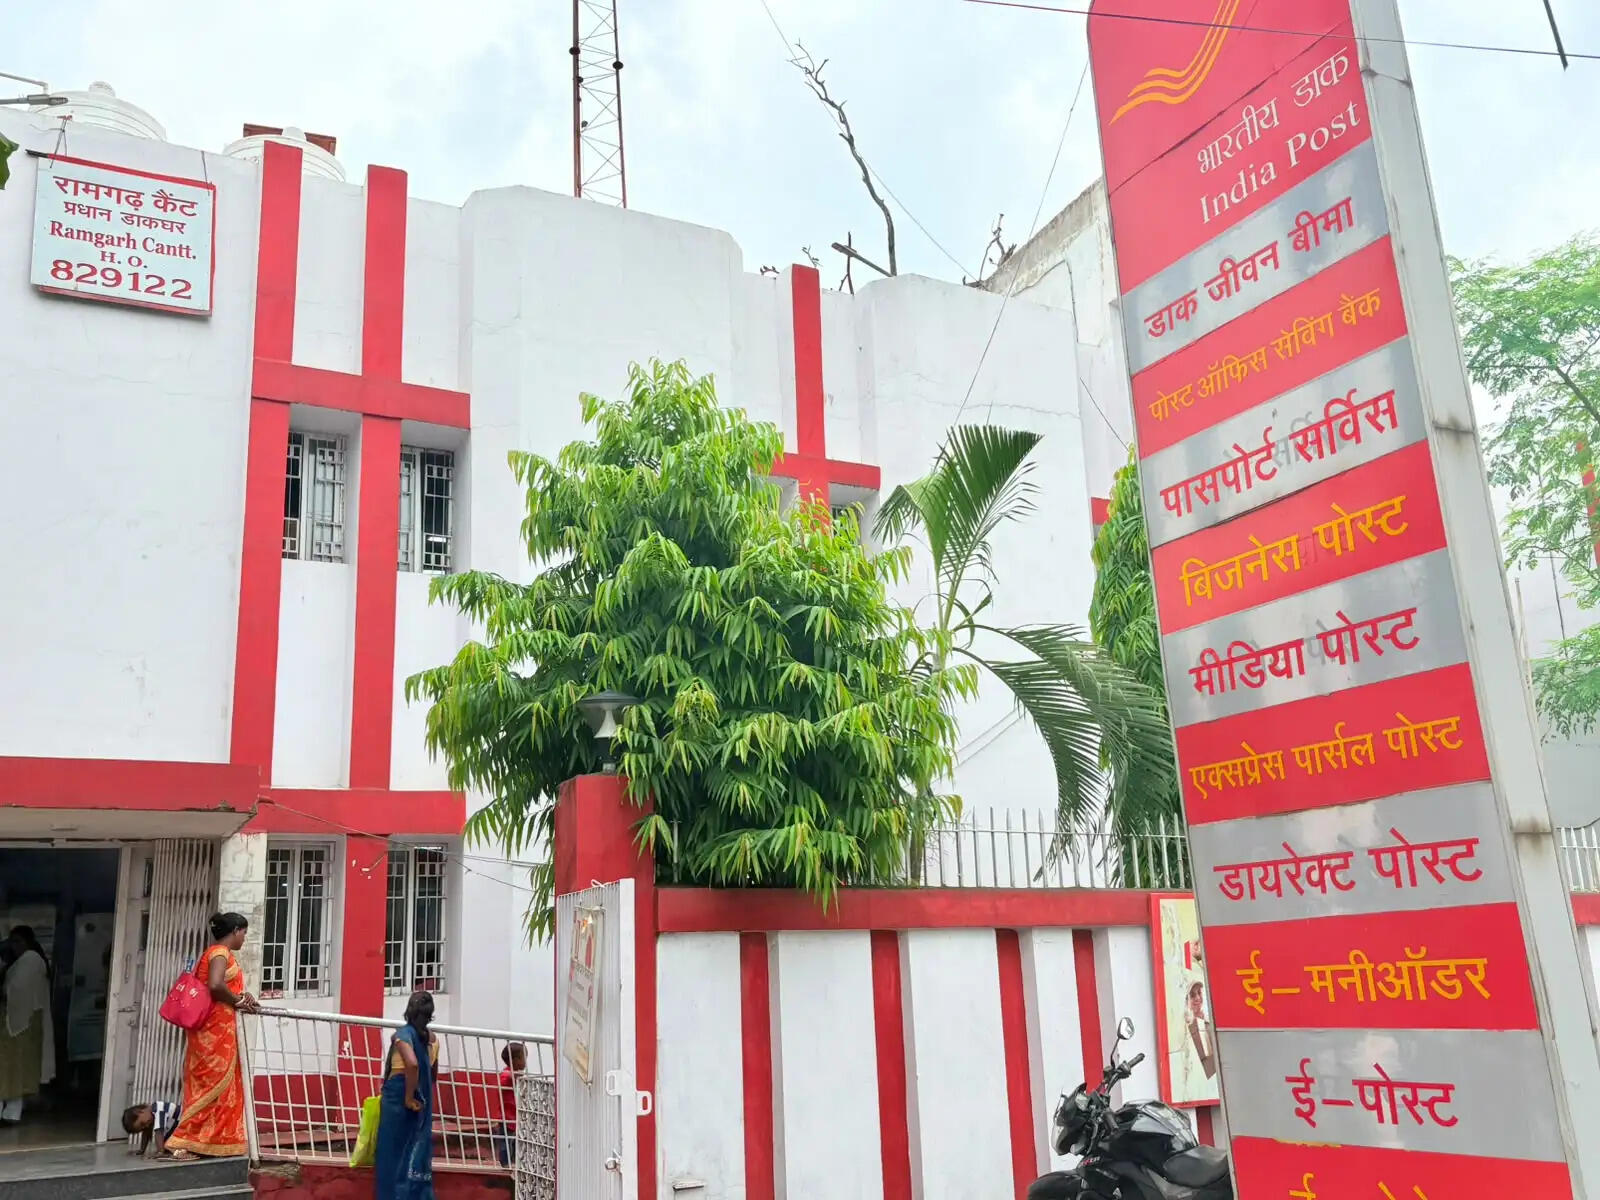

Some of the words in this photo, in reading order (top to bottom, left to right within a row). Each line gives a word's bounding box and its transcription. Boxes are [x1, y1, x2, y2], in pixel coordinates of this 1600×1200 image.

[1197, 97, 1280, 174] भारतीय
[1290, 46, 1349, 107] डाक
[152, 189, 198, 216] कैंट
[1200, 160, 1278, 224] India
[1286, 100, 1361, 168] Post
[50, 220, 137, 250] Ramgarh
[142, 237, 197, 260] Cantt.
[64, 201, 112, 222] प्रधान
[120, 211, 186, 234] डाकघर
[50, 259, 193, 300] 829122
[100, 251, 122, 265] H.
[128, 256, 148, 268] O.
[1144, 290, 1199, 338] डाक
[1203, 240, 1280, 302] जीवन
[1287, 197, 1354, 252] बीमा
[1149, 384, 1195, 422] पोस्ट
[1197, 346, 1269, 399] ऑफिस
[1160, 426, 1278, 518] पासपोर्ट
[1288, 388, 1398, 463] सर्विस
[1179, 533, 1301, 607] बिजनेस
[1313, 495, 1409, 557] पोस्ट
[1188, 638, 1306, 696] मीडिया
[1316, 607, 1420, 665] पोस्ट
[1189, 741, 1287, 800] एक्सप्रेस
[1291, 721, 1376, 776] पार्सल
[1382, 712, 1464, 760] पोस्ट
[1213, 841, 1357, 901] डायरेक्ट
[1368, 828, 1484, 889] पोस्ट
